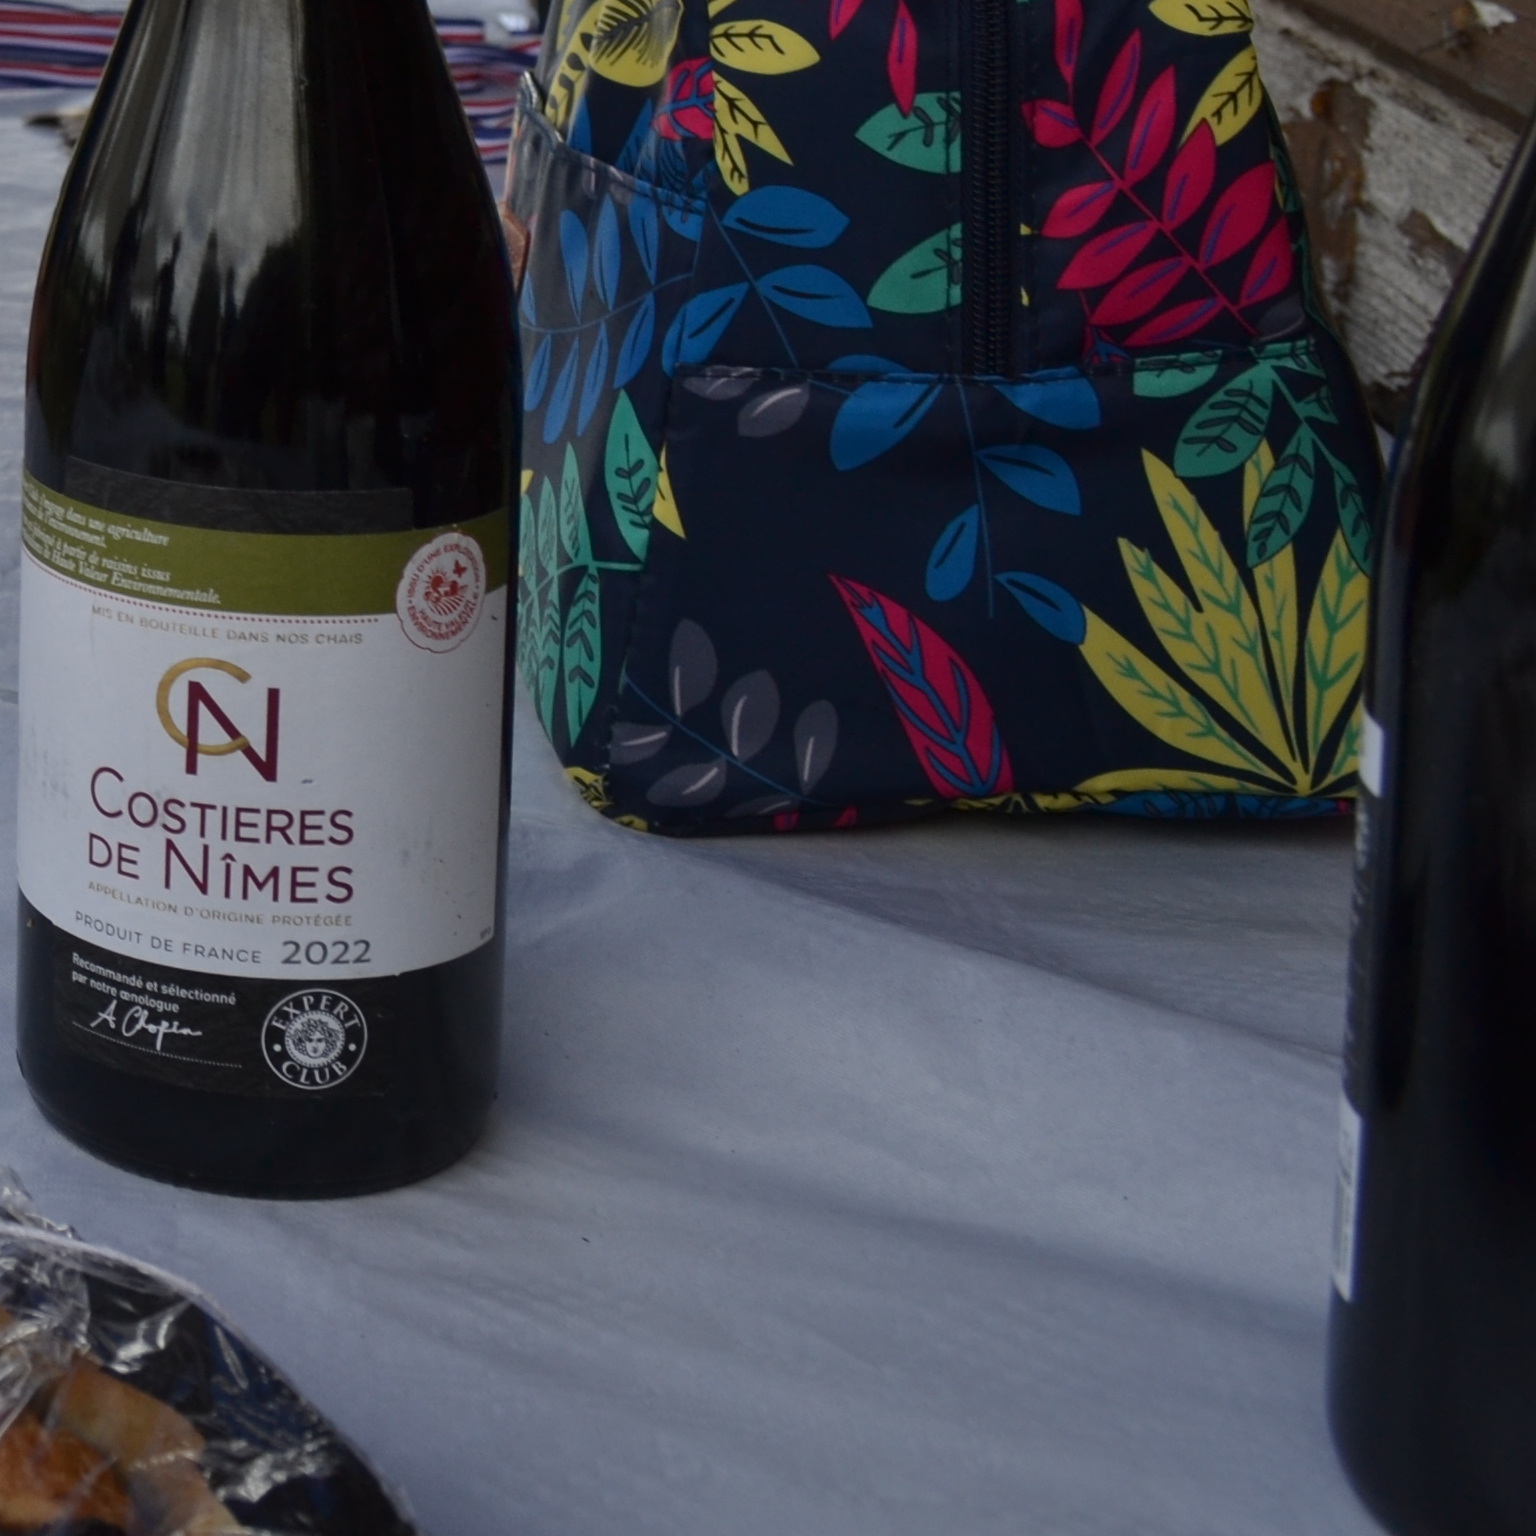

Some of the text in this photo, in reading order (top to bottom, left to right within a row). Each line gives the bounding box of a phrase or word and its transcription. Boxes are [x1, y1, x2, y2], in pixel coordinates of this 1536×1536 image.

[107, 524, 170, 546] agriculture
[141, 563, 172, 582] issus
[92, 604, 364, 645] MIS EN BOUTEILLE DANS NOS CHAIS
[88, 832, 355, 905] DE NÎMES
[88, 881, 353, 927] APPELLATION D'ORIGINE PROTÉGÉE
[75, 910, 262, 964] PRODUIT DE FRANCE
[281, 939, 372, 965] 2022
[71, 970, 180, 1013] par notre œnologue
[72, 952, 237, 1005] Recommandé et sélectionné
[272, 994, 363, 1032] EXPERT
[281, 1059, 348, 1086] CLUB
